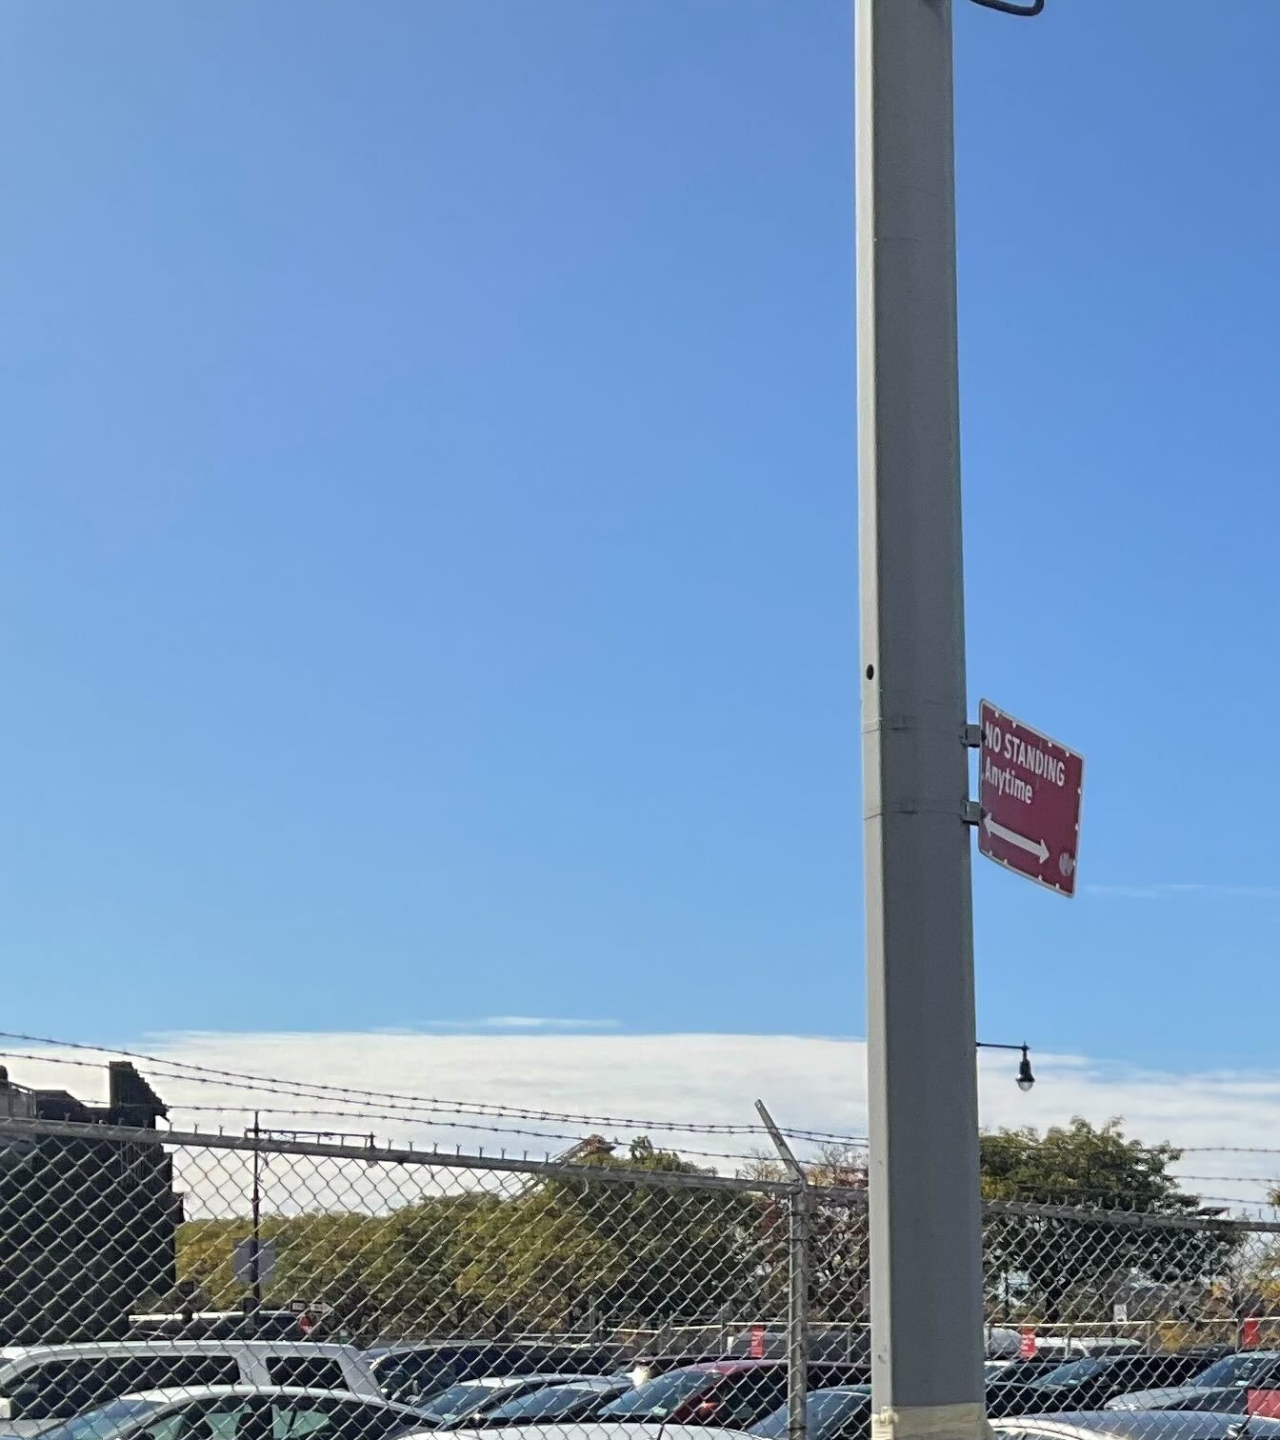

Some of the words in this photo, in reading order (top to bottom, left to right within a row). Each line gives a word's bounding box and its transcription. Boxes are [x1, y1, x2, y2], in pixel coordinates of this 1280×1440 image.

[985, 721, 1000, 753] NO
[1004, 733, 1066, 787] STANDING
[985, 757, 1033, 804] Anytime
